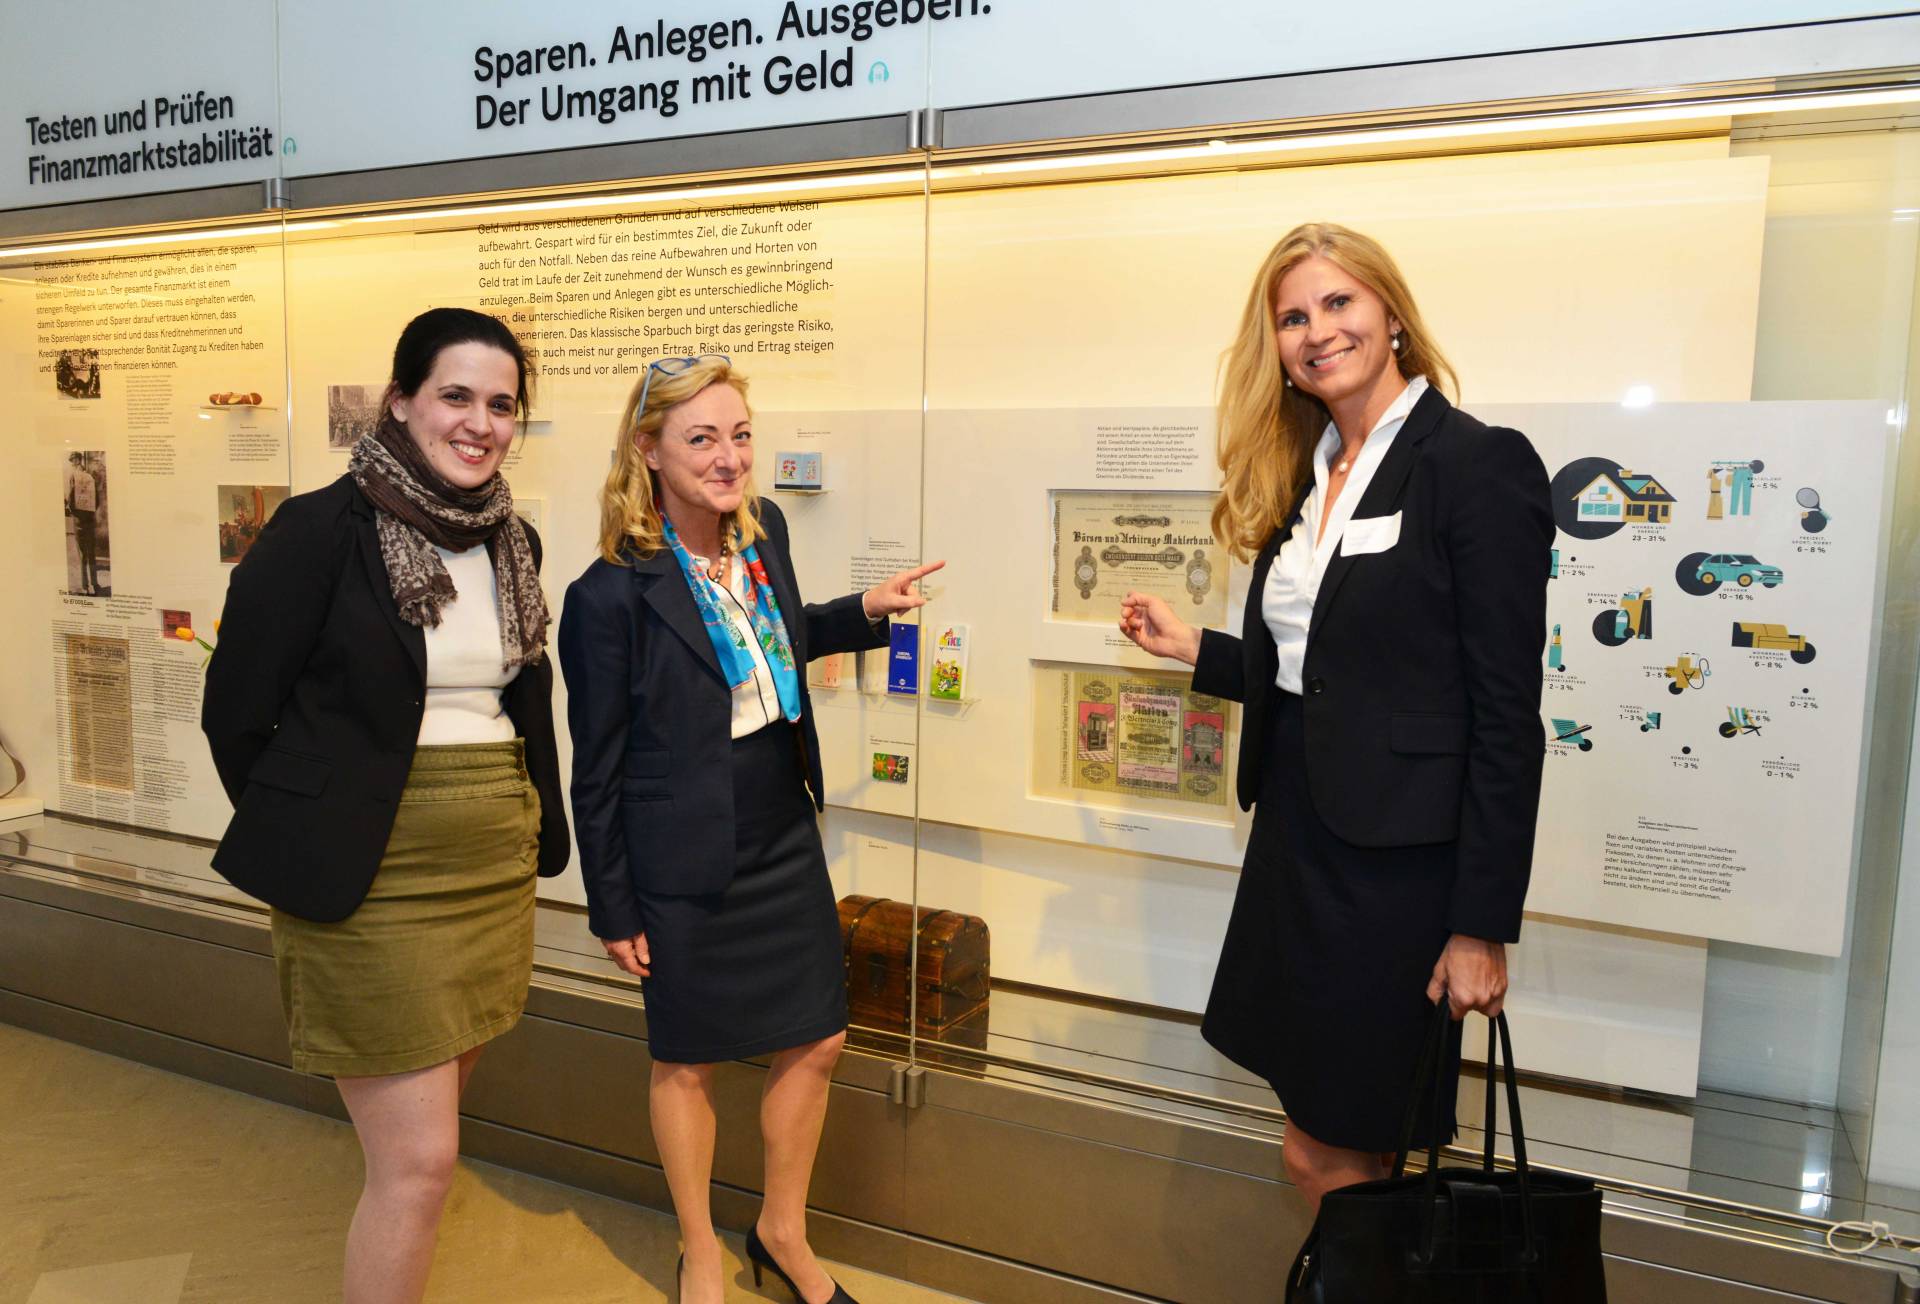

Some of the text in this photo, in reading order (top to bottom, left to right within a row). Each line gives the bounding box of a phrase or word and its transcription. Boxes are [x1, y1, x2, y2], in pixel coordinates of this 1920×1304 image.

[474, 0, 991, 88] Sparen. Anlegen. Ausgeben.
[476, 47, 853, 129] Der Umgang mit Geld
[26, 91, 233, 146] Testen und Prüfen
[28, 126, 273, 184] Finanzmarktstabilität
[479, 220, 812, 252] aufbewahrt. Gespart wird für ein bestimmtes Ziel, die Zukunft oder
[479, 243, 817, 270] auch für den Notfall. Neben das reine Aufbewahren und Horten von
[479, 258, 832, 287] Geld trat im Laufe der Zeit zunehmend der Wunsch es gewinnbringend
[65, 301, 96, 315] Regelwerk
[165, 299, 183, 307] muss
[185, 294, 225, 308] eingehalten
[228, 293, 255, 304] werden,
[480, 293, 527, 307] anzulegen.
[530, 293, 552, 303] Beim
[556, 292, 589, 305] Sparen
[593, 289, 611, 300] und
[615, 288, 654, 302] Anlegen
[658, 286, 676, 301] gibt
[695, 281, 782, 296] unterschiedliche
[786, 279, 834, 295] Möglich-
[37, 309, 236, 331] damit Sparerinnen und Sparer darauf vertrauen können, dass
[512, 301, 798, 322] die unterschiedliche Risiken bergen und unterschiedliche
[51, 331, 90, 345] Spareinlagen
[93, 330, 111, 340] sicher
[114, 329, 126, 339] sind
[129, 329, 141, 339] und
[144, 328, 158, 338] dass
[161, 326, 226, 337] Kreditnehmerinnen
[229, 324, 243, 334] und
[570, 328, 587, 338] Das
[591, 325, 640, 337] klassische
[644, 323, 691, 339] Sparbuch
[695, 323, 719, 337] birgt
[723, 322, 741, 333] das
[745, 322, 793, 336] geringste
[798, 320, 833, 332] Risiko,
[147, 343, 170, 353] Bonität
[173, 343, 197, 355] Zugang
[209, 341, 239, 351] Krediten
[241, 339, 263, 350] haben
[543, 341, 833, 359] auch meist nur geringen Ertrag. Risiko und Ertrag steigen
[543, 363, 638, 375] Fonds und vor allem
